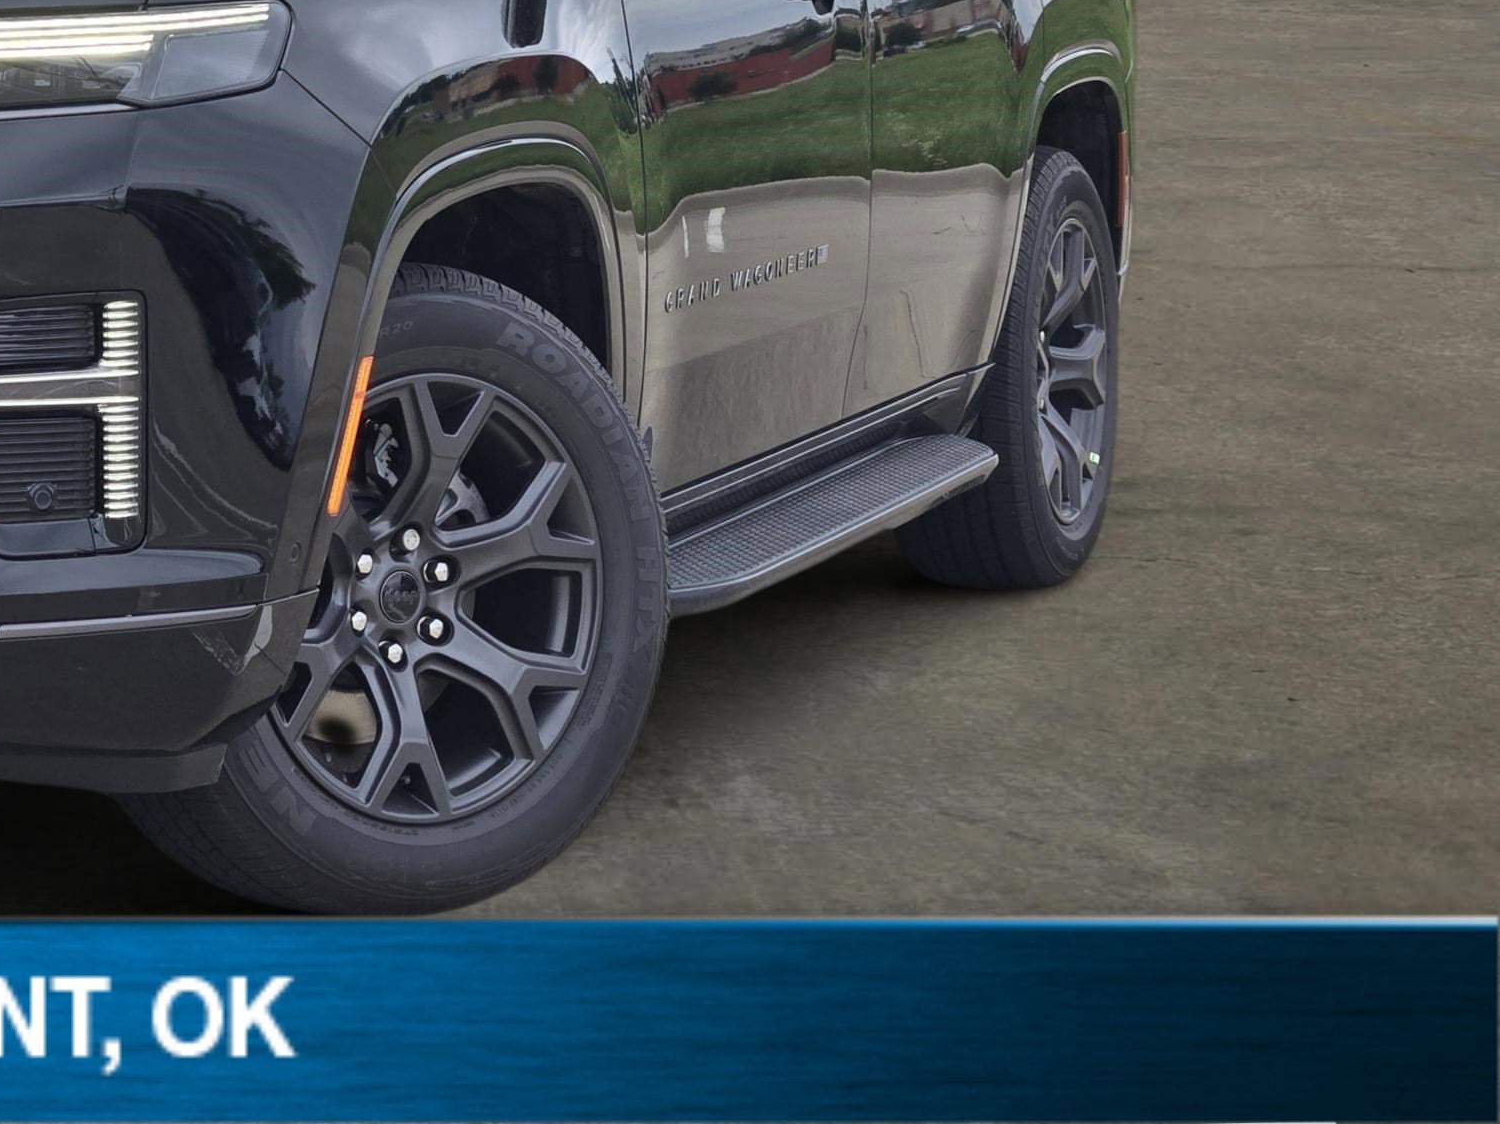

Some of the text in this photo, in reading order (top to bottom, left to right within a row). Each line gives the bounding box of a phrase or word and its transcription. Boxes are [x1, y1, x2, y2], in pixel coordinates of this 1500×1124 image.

[664, 246, 818, 314] GRAND WAGONEER
[495, 321, 651, 524] ROADIAN
